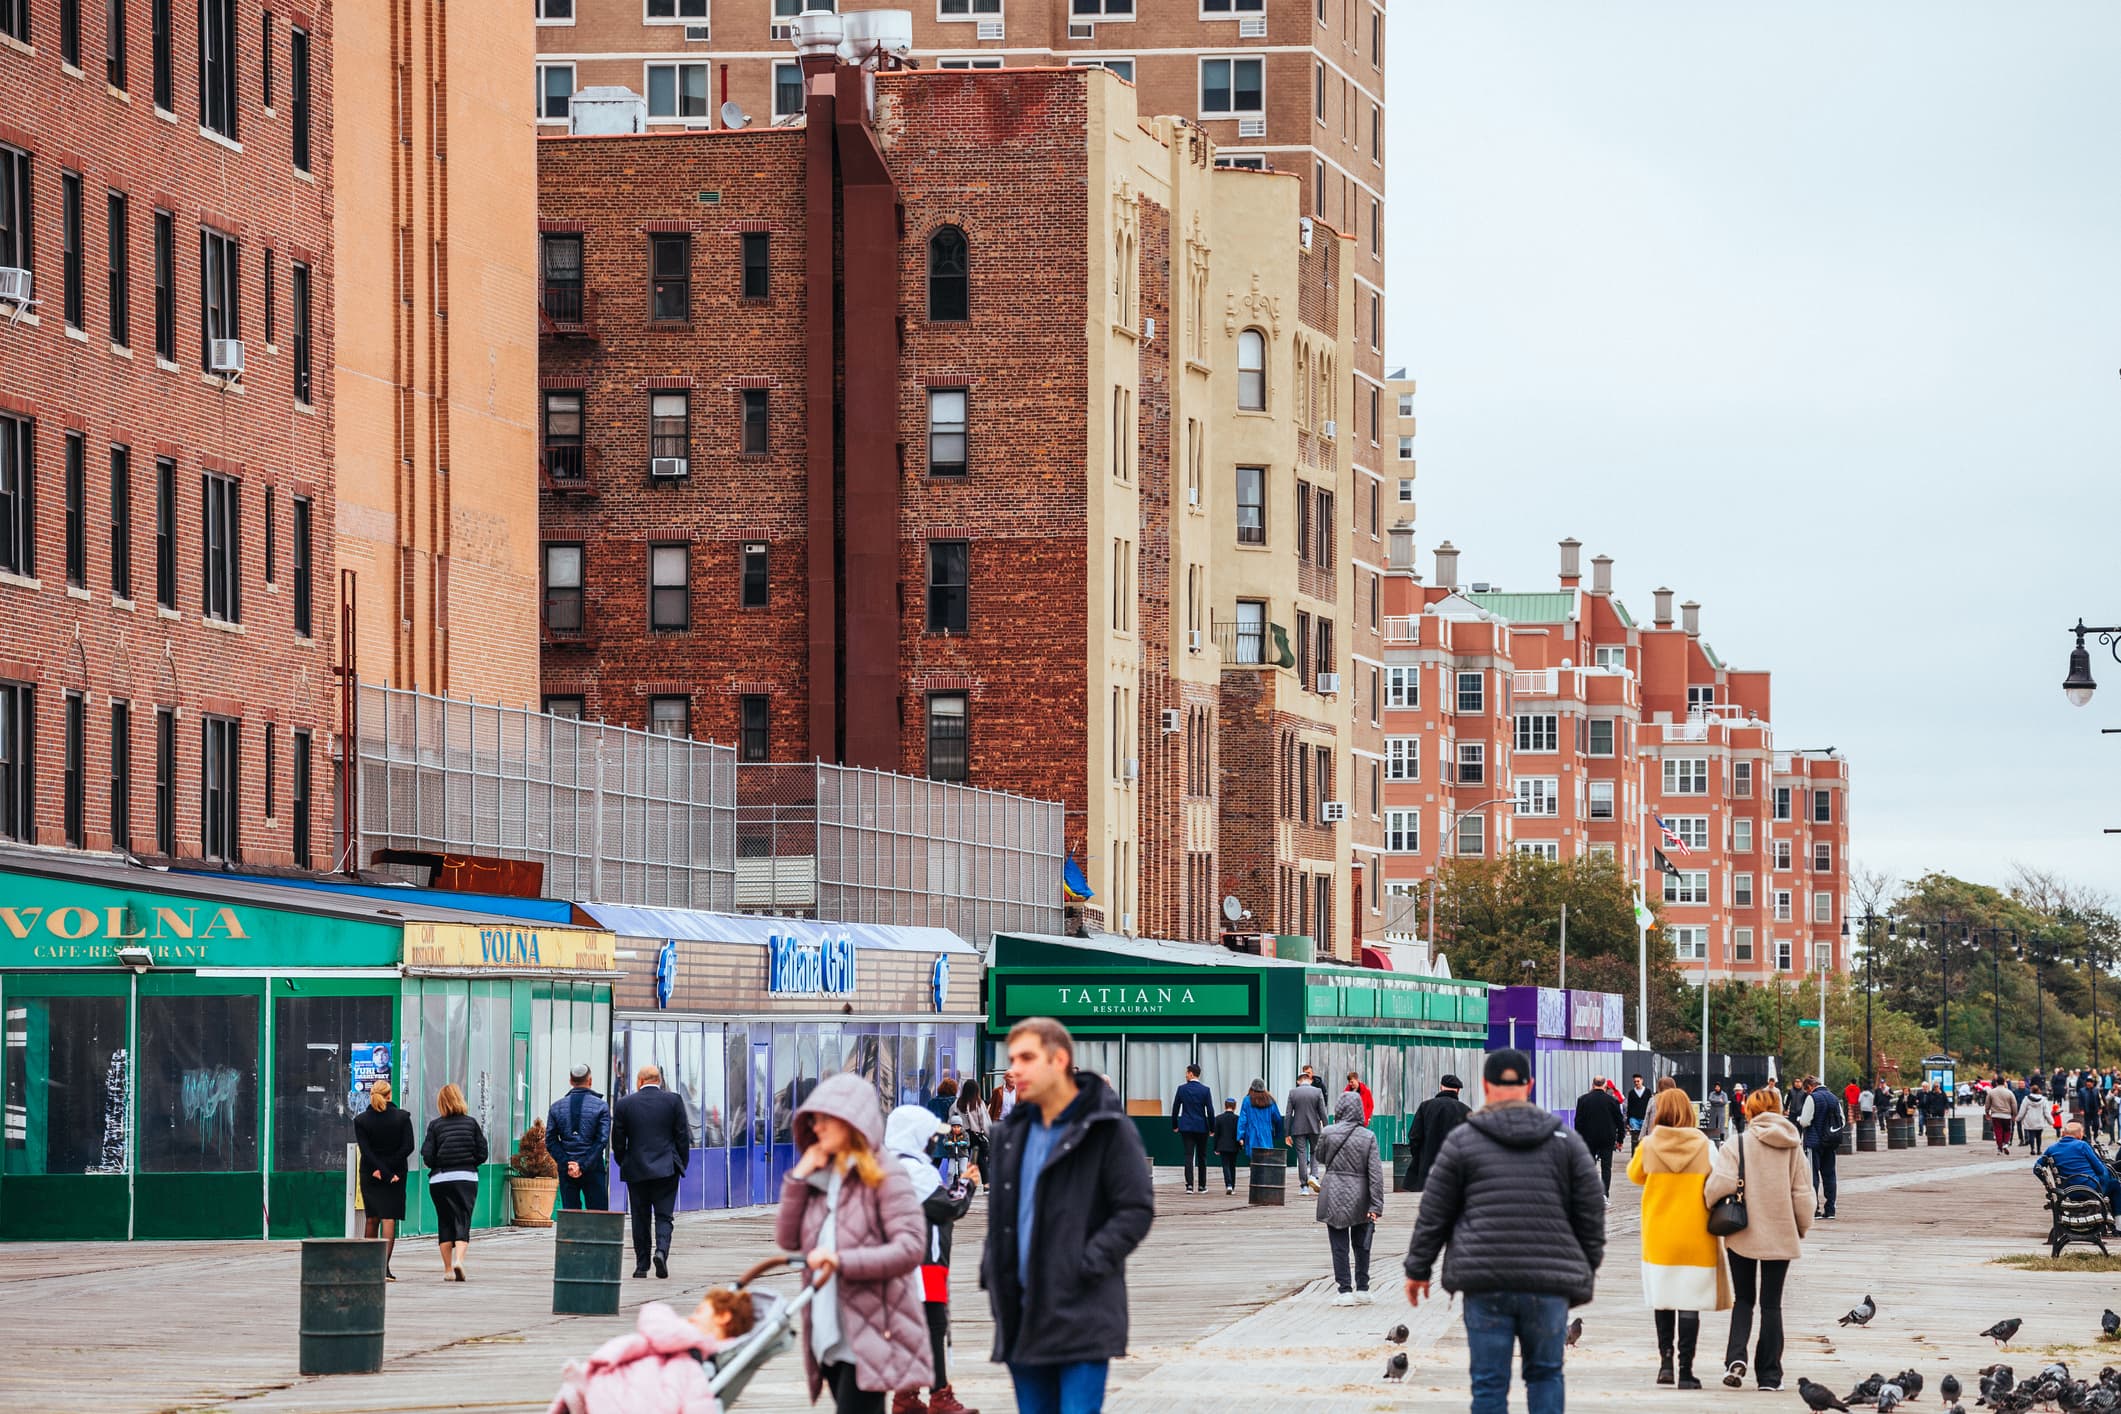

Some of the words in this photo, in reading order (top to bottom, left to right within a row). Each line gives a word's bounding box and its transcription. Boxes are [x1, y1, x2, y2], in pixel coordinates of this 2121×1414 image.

[0, 906, 251, 939] VOLNA
[479, 928, 541, 965] VOLNA
[1058, 988, 1195, 1003] TATIANA
[1093, 1005, 1163, 1013] RESTAURANT
